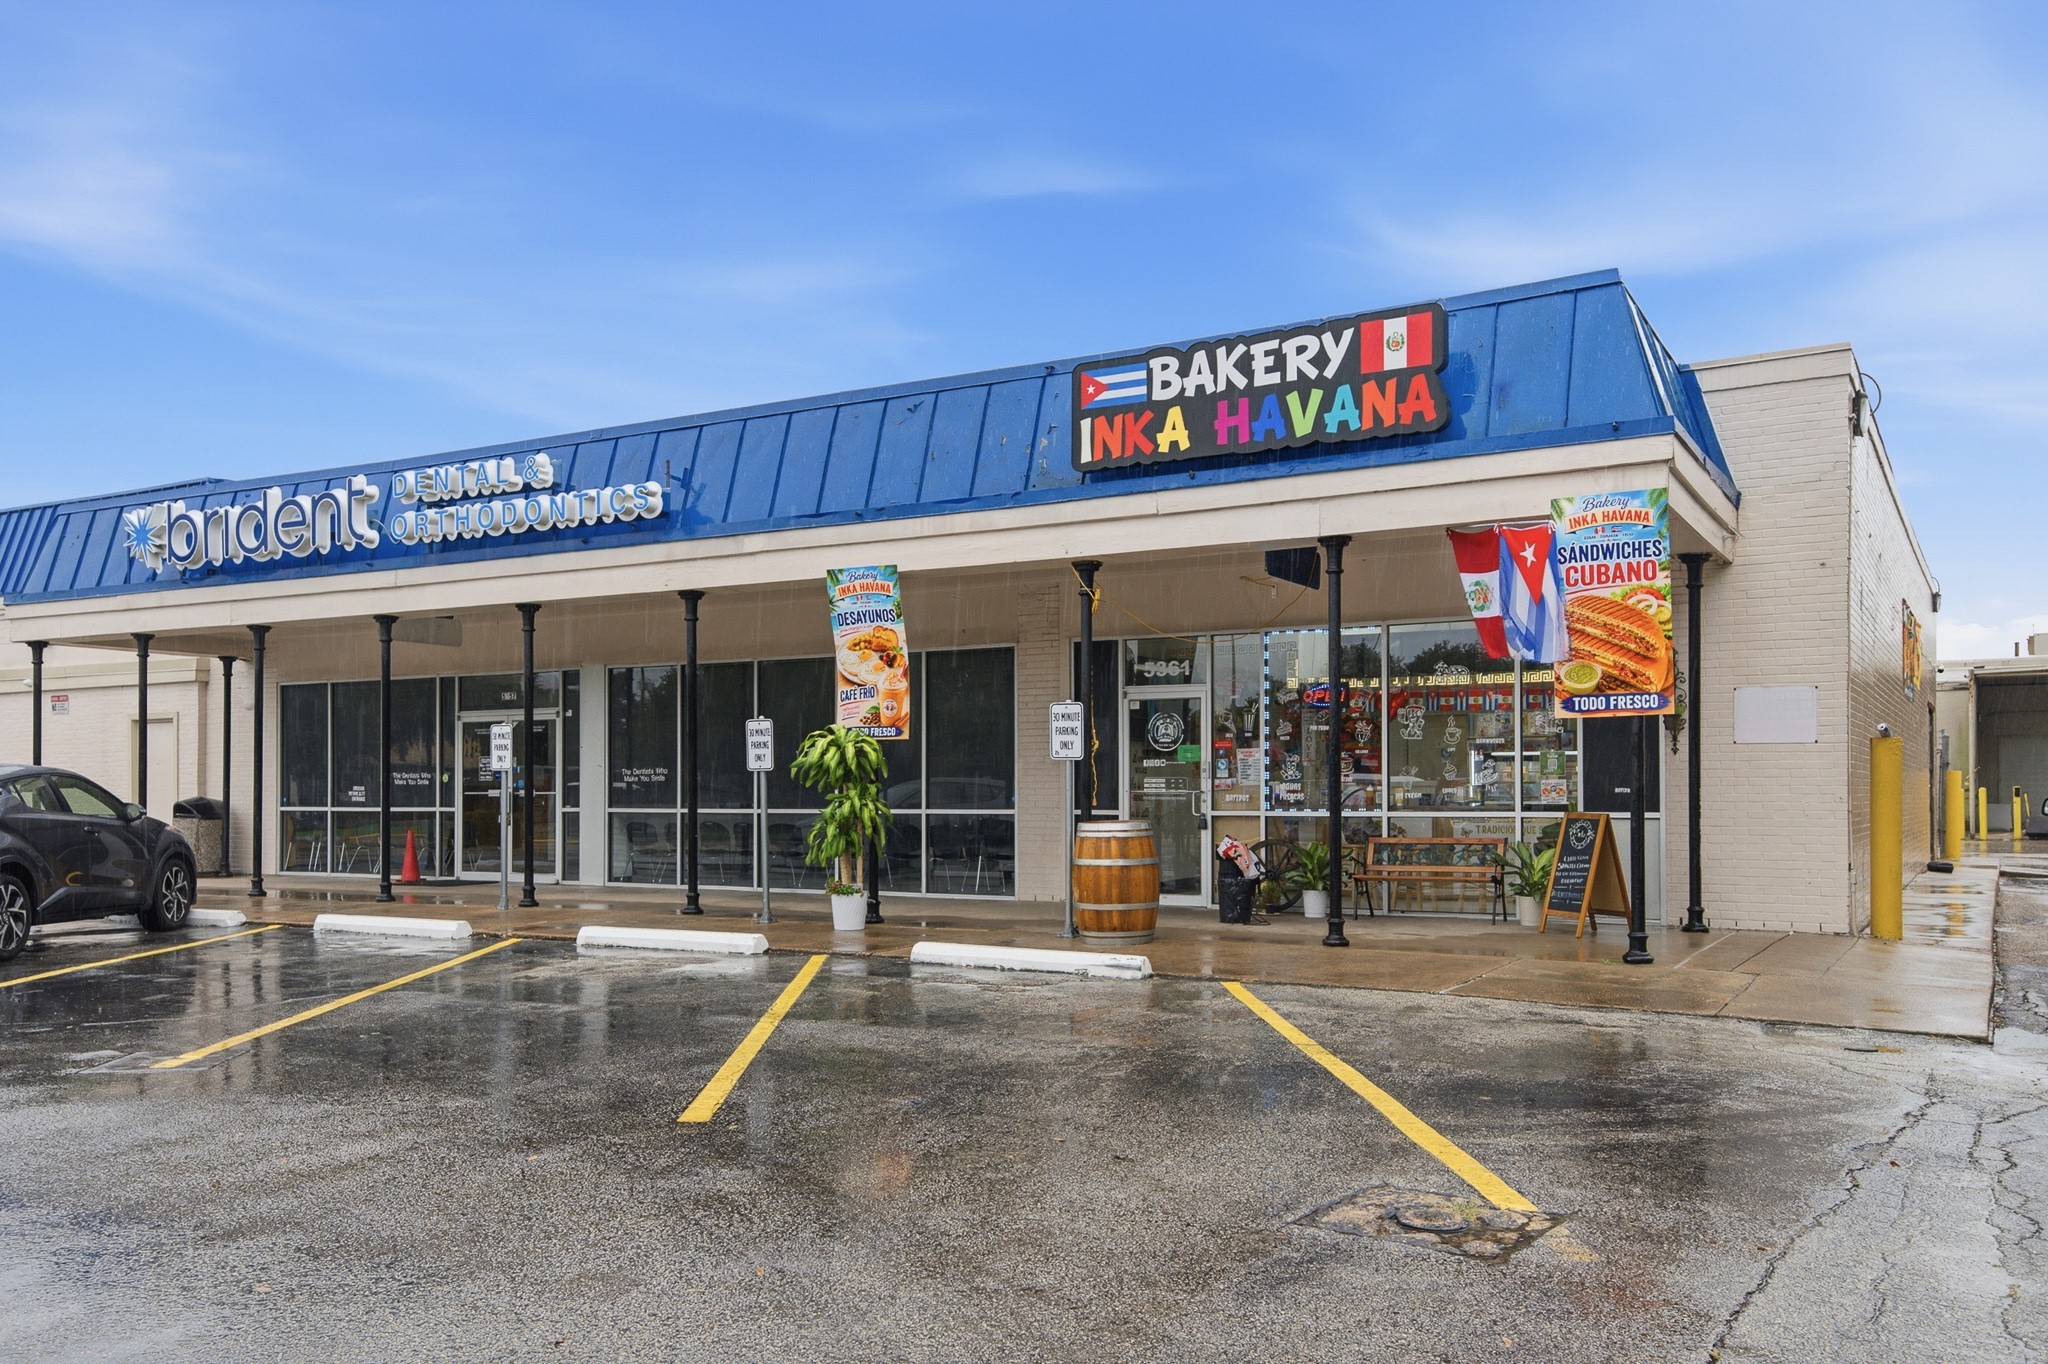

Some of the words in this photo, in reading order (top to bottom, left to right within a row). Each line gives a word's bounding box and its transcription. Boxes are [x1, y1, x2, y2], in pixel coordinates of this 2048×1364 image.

[1148, 327, 1355, 402] BAKERY
[1079, 405, 1191, 464] INKA
[1214, 373, 1438, 446] HAVANA
[392, 462, 510, 497] DENTAL
[522, 456, 541, 482] &
[1582, 496, 1631, 512] Bakery
[166, 478, 370, 564] brident
[391, 486, 651, 541] ORTHODONTICS
[1568, 512, 1598, 530] INKA
[1601, 509, 1650, 525] HAVANA
[1557, 538, 1663, 565] SÁNDWICHES
[847, 571, 880, 582] Bakery
[1564, 559, 1658, 588] CUBANO
[838, 583, 859, 597] INKA
[859, 581, 892, 595] HAVANA
[837, 608, 896, 627] DESAYUNOS
[1573, 696, 1606, 711] TODO
[1609, 694, 1659, 710] FRESCO
[1053, 712, 1060, 722] 30
[1061, 712, 1080, 722] MINUTE
[755, 728, 771, 737] MINUTE
[870, 727, 896, 737] FRESCO
[1055, 727, 1078, 736] PARKING
[751, 741, 770, 749] PARKING
[1060, 740, 1074, 750] ONLY
[497, 755, 506, 763] ONLY
[754, 754, 766, 762] ONLY
